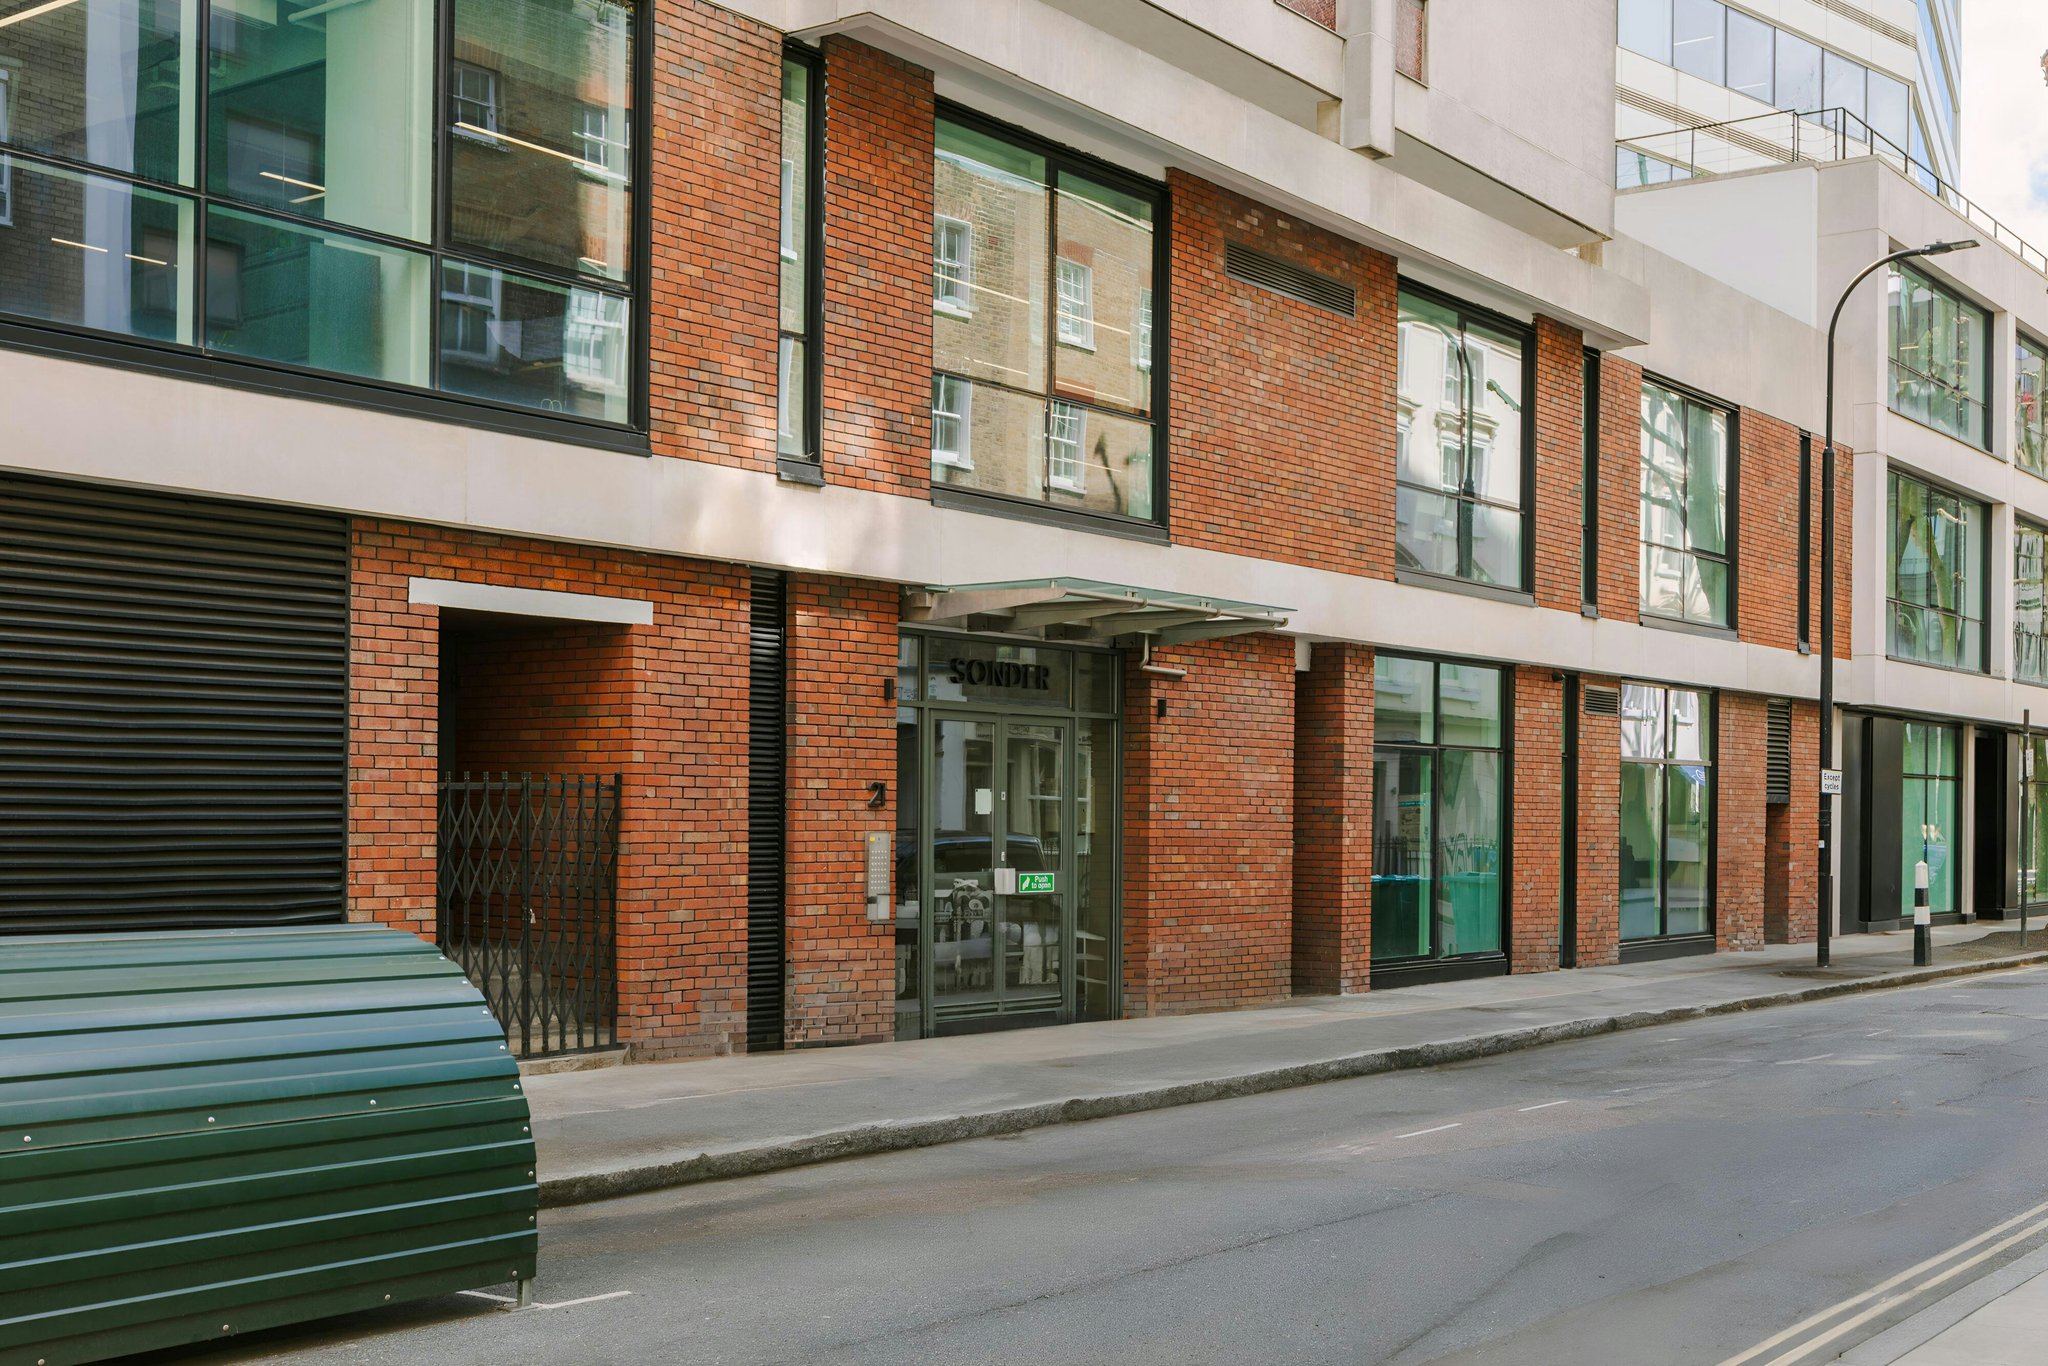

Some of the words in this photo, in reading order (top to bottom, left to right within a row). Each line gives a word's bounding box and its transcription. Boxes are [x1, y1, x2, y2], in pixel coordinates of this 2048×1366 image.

[867, 782, 886, 807] 21
[1034, 875, 1048, 883] Push
[1038, 882, 1051, 890] open
